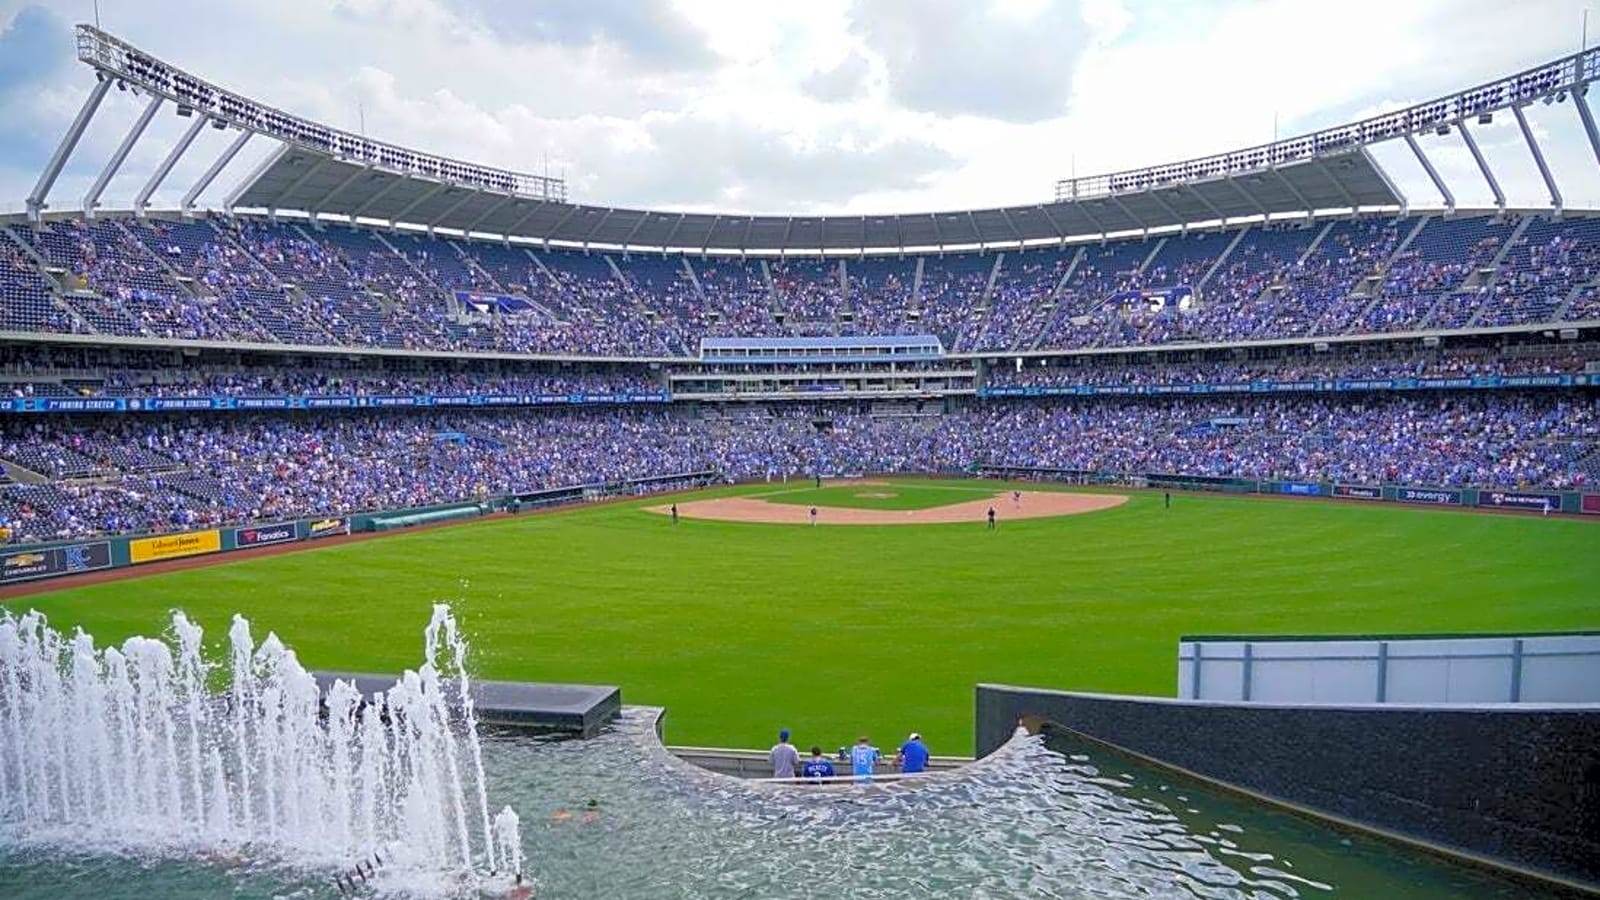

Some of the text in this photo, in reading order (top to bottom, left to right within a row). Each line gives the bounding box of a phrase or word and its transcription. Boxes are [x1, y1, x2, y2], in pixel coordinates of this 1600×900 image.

[60, 400, 83, 409] INNING
[86, 400, 115, 409] STRETCH
[1416, 491, 1451, 503] evergy
[257, 531, 290, 541] Fanatics
